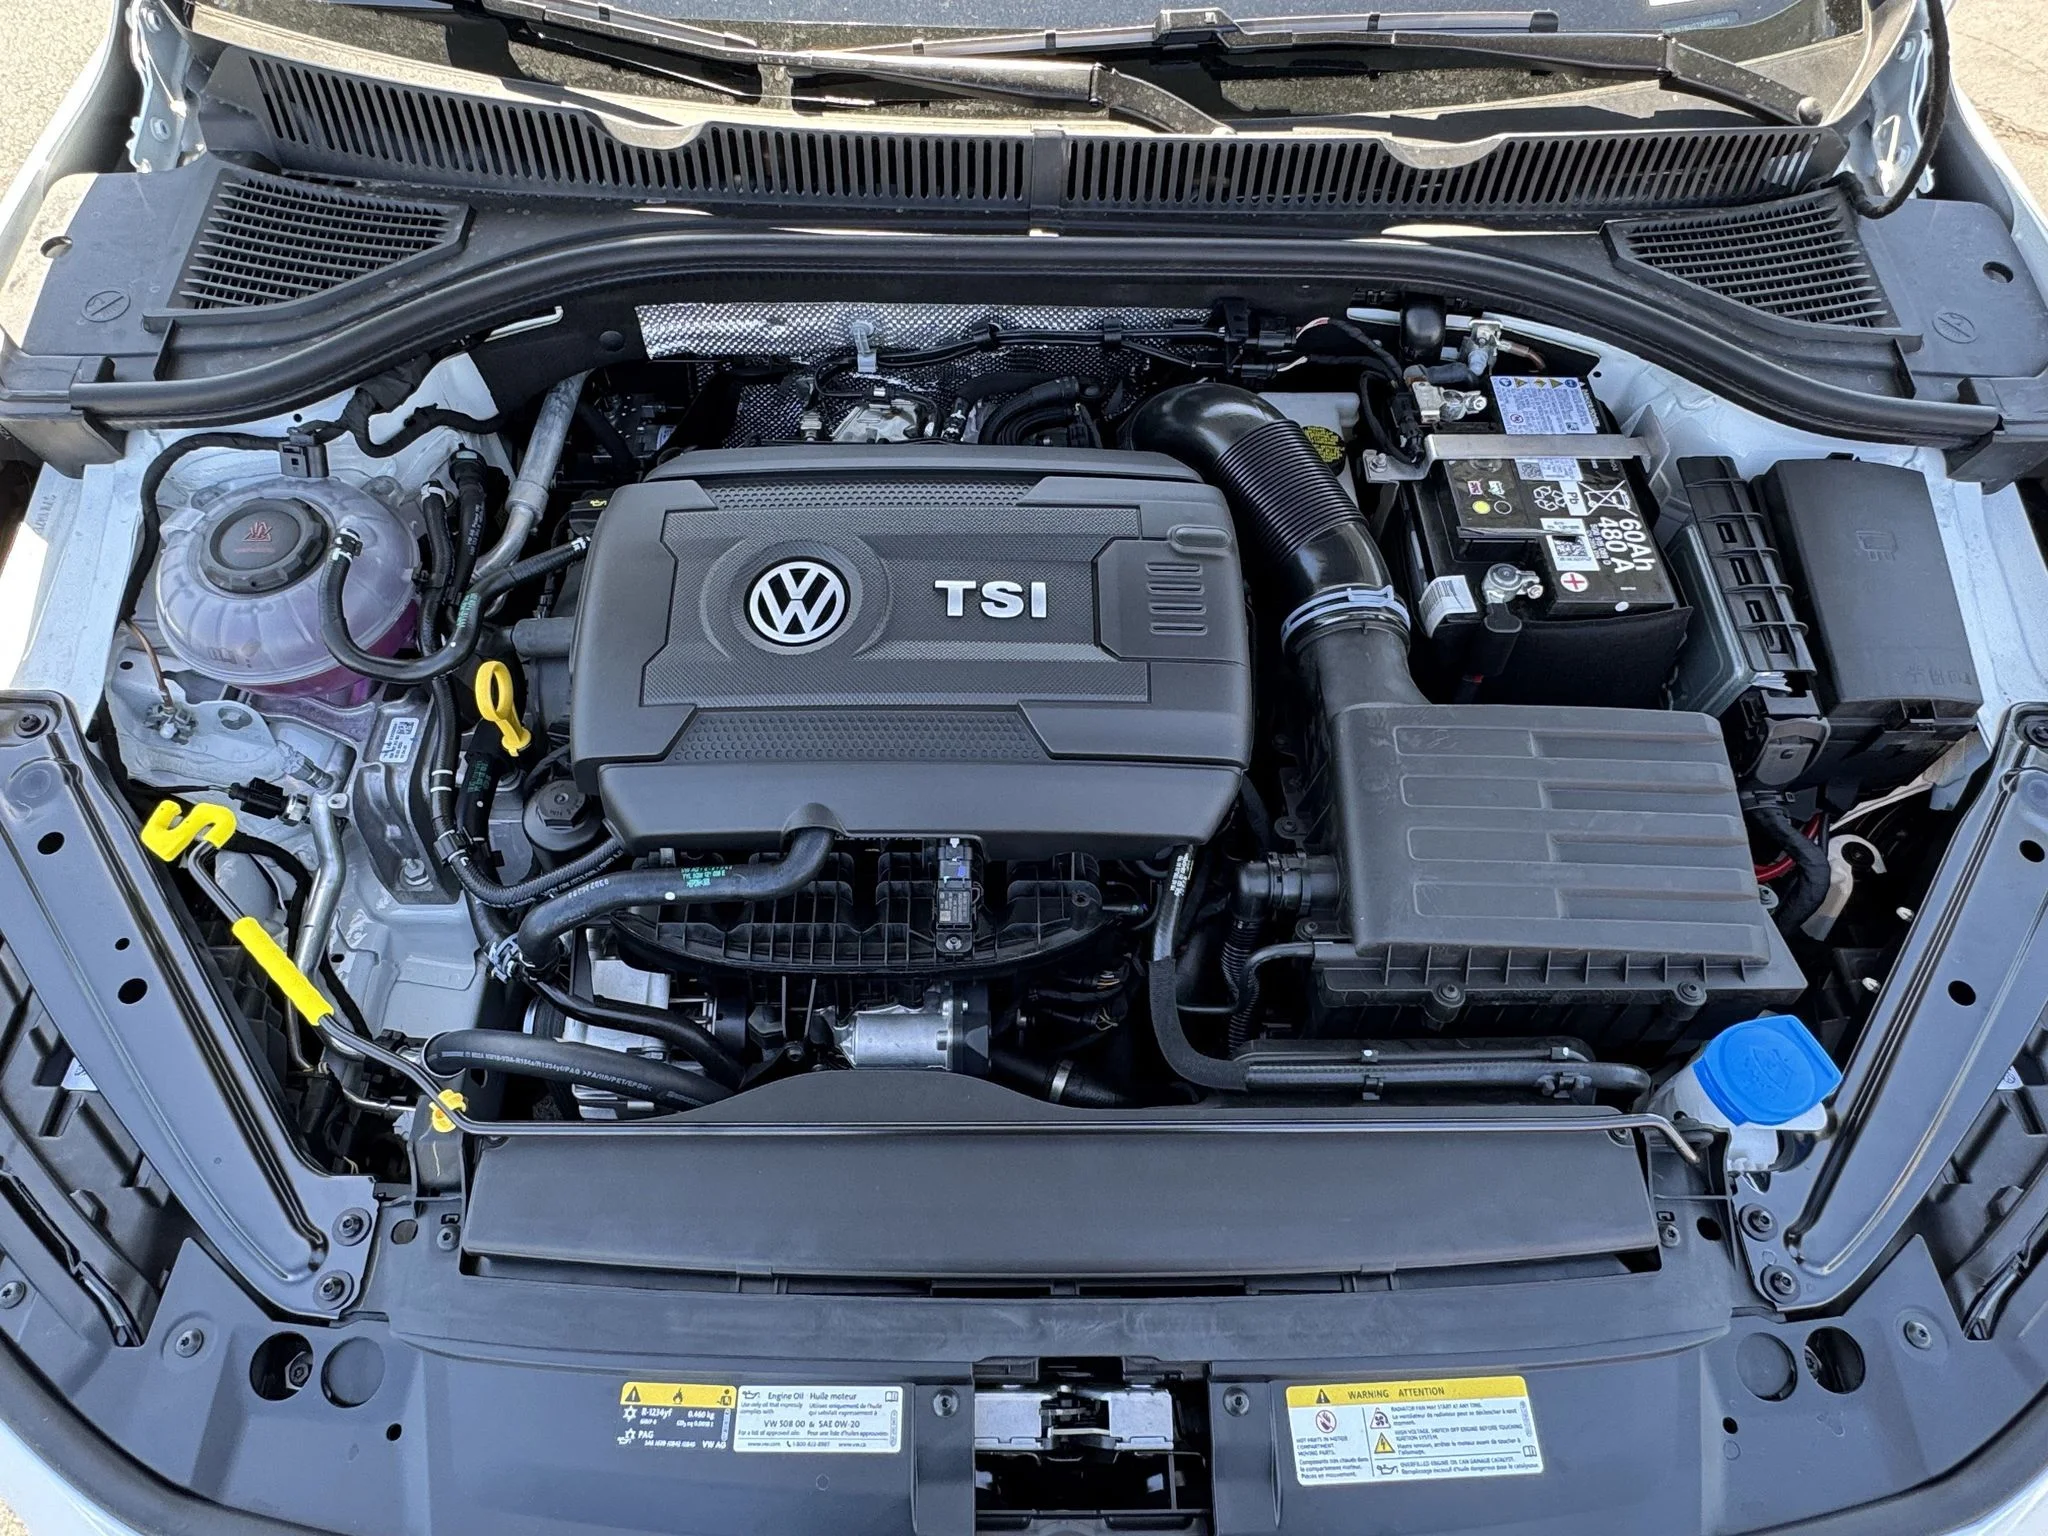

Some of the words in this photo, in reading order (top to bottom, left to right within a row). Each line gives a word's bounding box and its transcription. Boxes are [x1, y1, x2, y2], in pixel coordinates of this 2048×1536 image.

[1567, 491, 1580, 505] Pb
[1598, 516, 1628, 553] 480
[1619, 518, 1656, 571] 60Ah
[1610, 557, 1635, 574] A
[934, 579, 1048, 619] TSI
[768, 1391, 792, 1402] Engine
[793, 1392, 804, 1400] Oil
[810, 1392, 829, 1400] Huile
[830, 1392, 857, 1400] moteur
[1348, 1389, 1389, 1400] WARNING
[1398, 1387, 1445, 1397] ATTENTION
[706, 1411, 715, 1420] kg
[764, 1420, 778, 1428] VW
[780, 1420, 793, 1428] 508
[794, 1420, 806, 1428] 00
[818, 1420, 833, 1428] SAE
[638, 1430, 654, 1439] PAG
[702, 1440, 714, 1448] VW
[715, 1441, 727, 1449] AG
